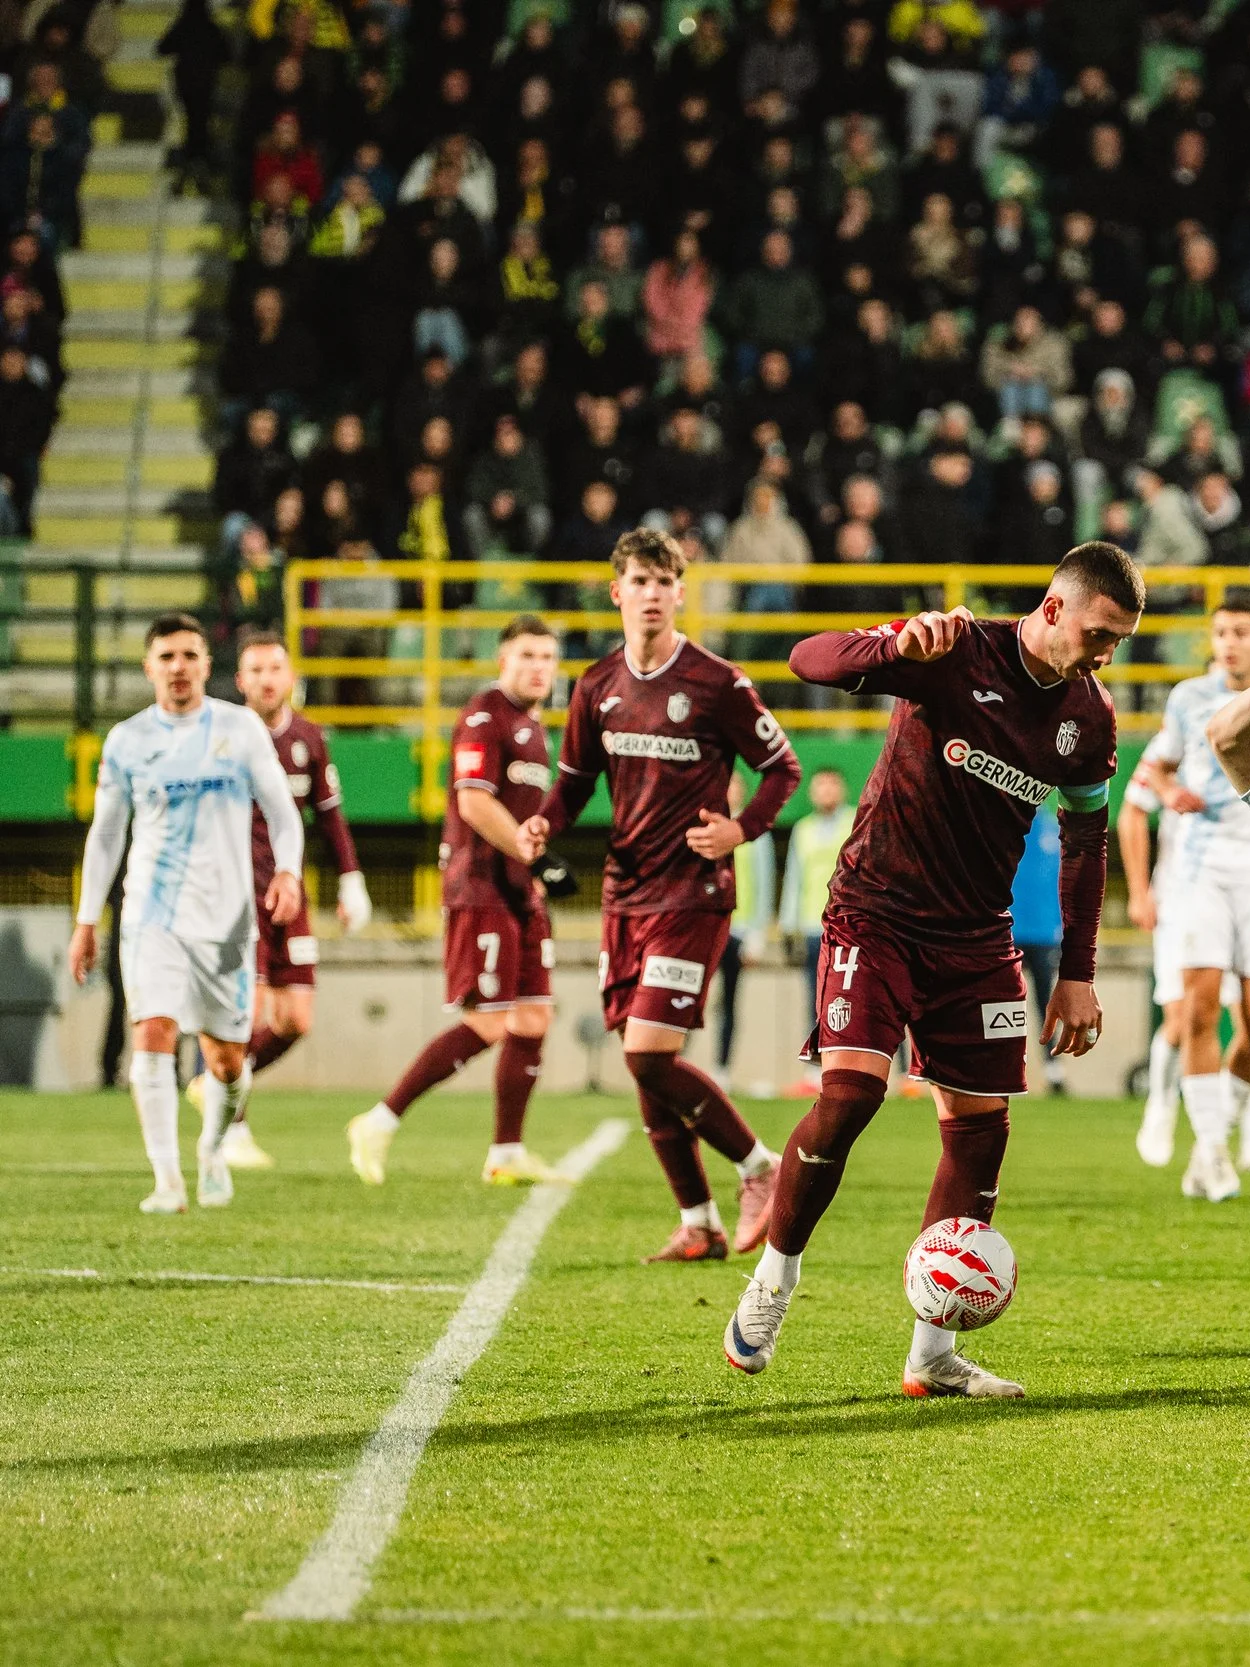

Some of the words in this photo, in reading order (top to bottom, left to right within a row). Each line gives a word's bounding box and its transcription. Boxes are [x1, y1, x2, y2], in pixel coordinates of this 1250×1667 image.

[477, 932, 500, 972] 7
[833, 946, 860, 990] 4
[920, 1272, 941, 1305] uhlsport
